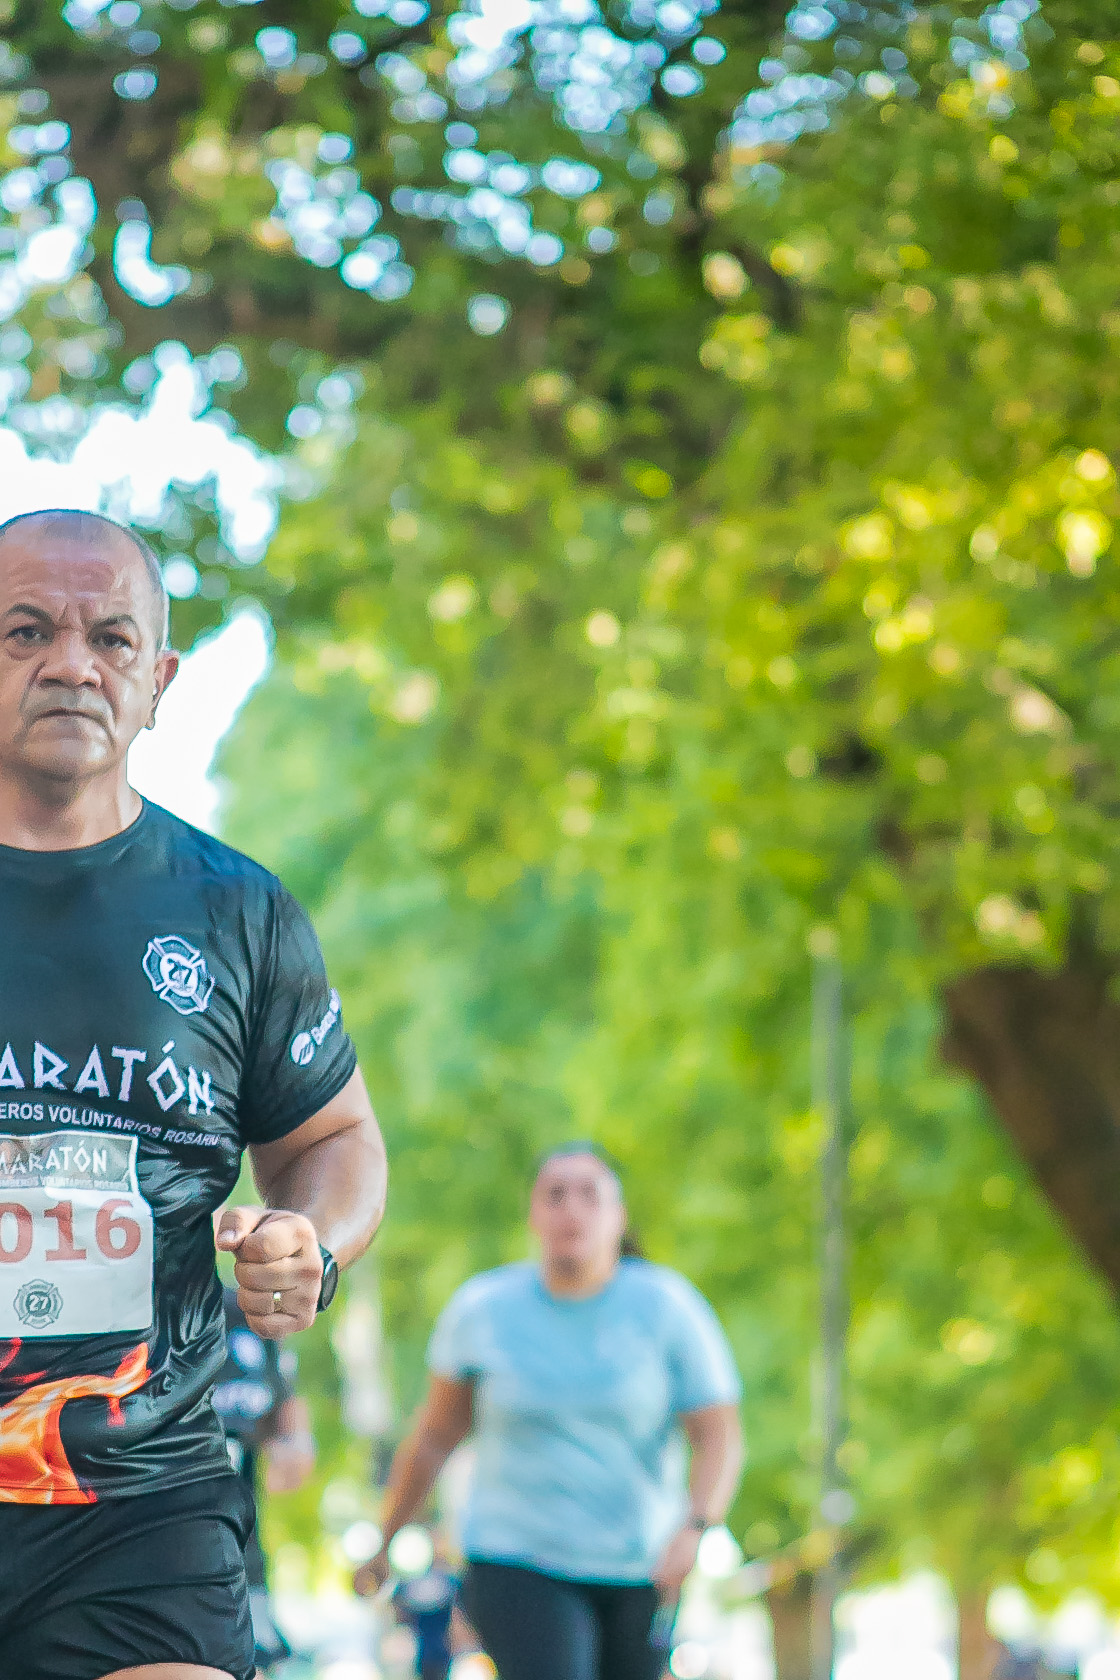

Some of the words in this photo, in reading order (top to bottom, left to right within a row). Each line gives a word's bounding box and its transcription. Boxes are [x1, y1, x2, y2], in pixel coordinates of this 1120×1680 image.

[167, 958, 193, 986] 27
[48, 1105, 162, 1137] VOLUNTARIOS
[29, 1294, 49, 1312] 27
